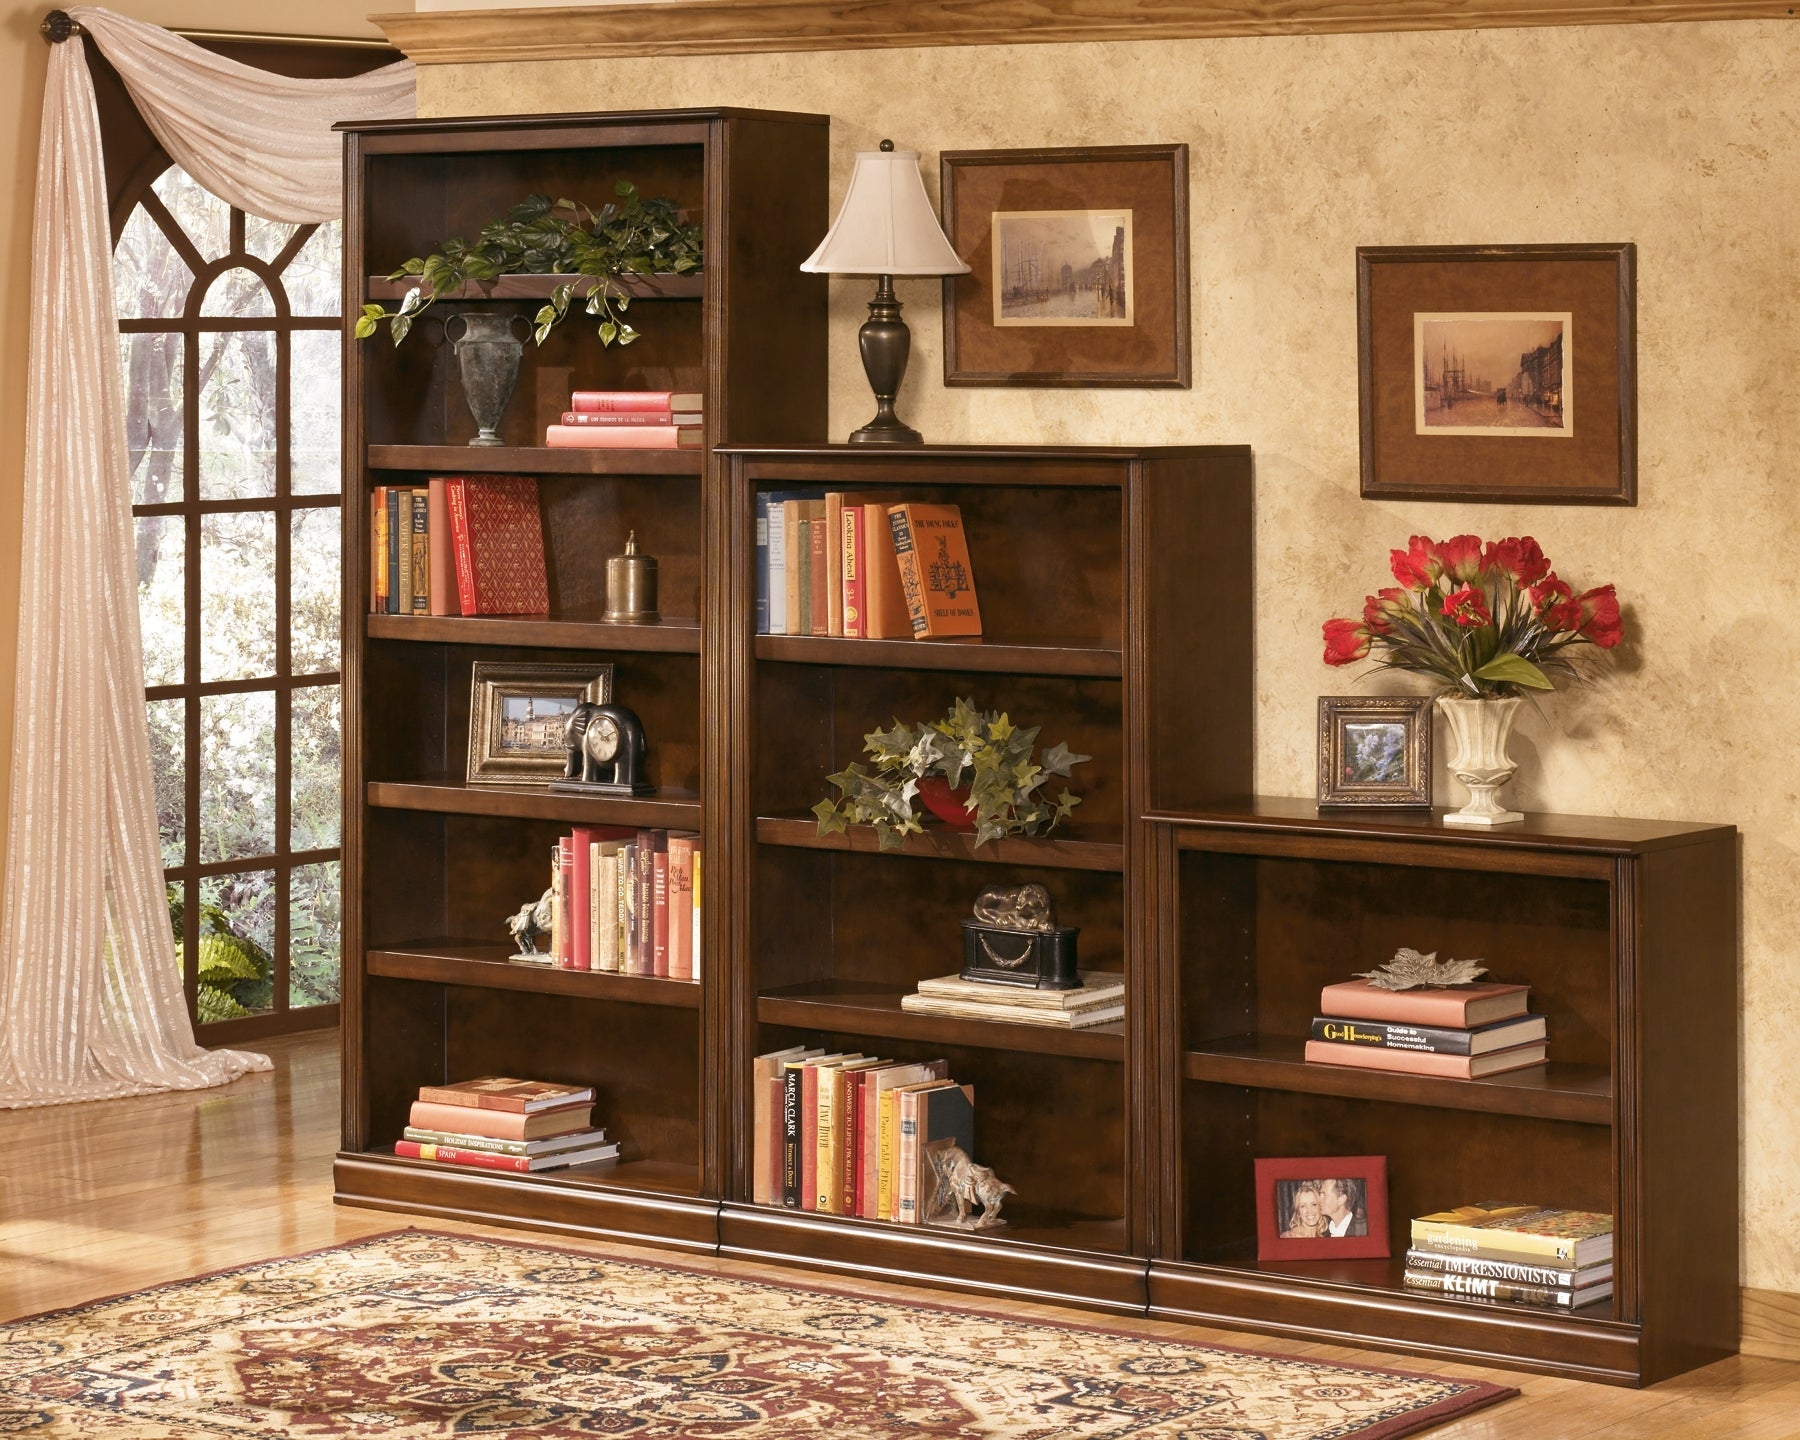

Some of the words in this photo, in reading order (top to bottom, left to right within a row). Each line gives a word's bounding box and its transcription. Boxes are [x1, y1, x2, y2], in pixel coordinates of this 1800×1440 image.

[401, 520, 409, 550] VIPER
[401, 552, 409, 585] THREE
[846, 551, 855, 579] Ahead
[957, 608, 974, 617] BOOKS
[618, 872, 625, 885] TO
[1386, 1026, 1409, 1035] Guide
[1409, 1028, 1418, 1036] to
[1386, 1033, 1427, 1044] Successful
[1386, 1041, 1435, 1052] Homemaking
[787, 1073, 797, 1108] MARCIA
[787, 1107, 797, 1137] CLARK
[819, 1104, 830, 1122] CANE
[819, 1125, 831, 1148] RIVER
[880, 1115, 889, 1140] Papa's
[438, 1149, 457, 1160] SPAIN
[443, 1136, 468, 1146] HOLIDAY
[467, 1138, 504, 1151] INSPIRATIONS
[880, 1143, 890, 1166] Table
[1427, 1231, 1479, 1251] gardening
[1408, 1255, 1443, 1270] Essential
[1444, 1259, 1558, 1286] IMPRESSIONISTS
[1405, 1274, 1441, 1289] Essential
[1443, 1273, 1500, 1297] KLIMT
